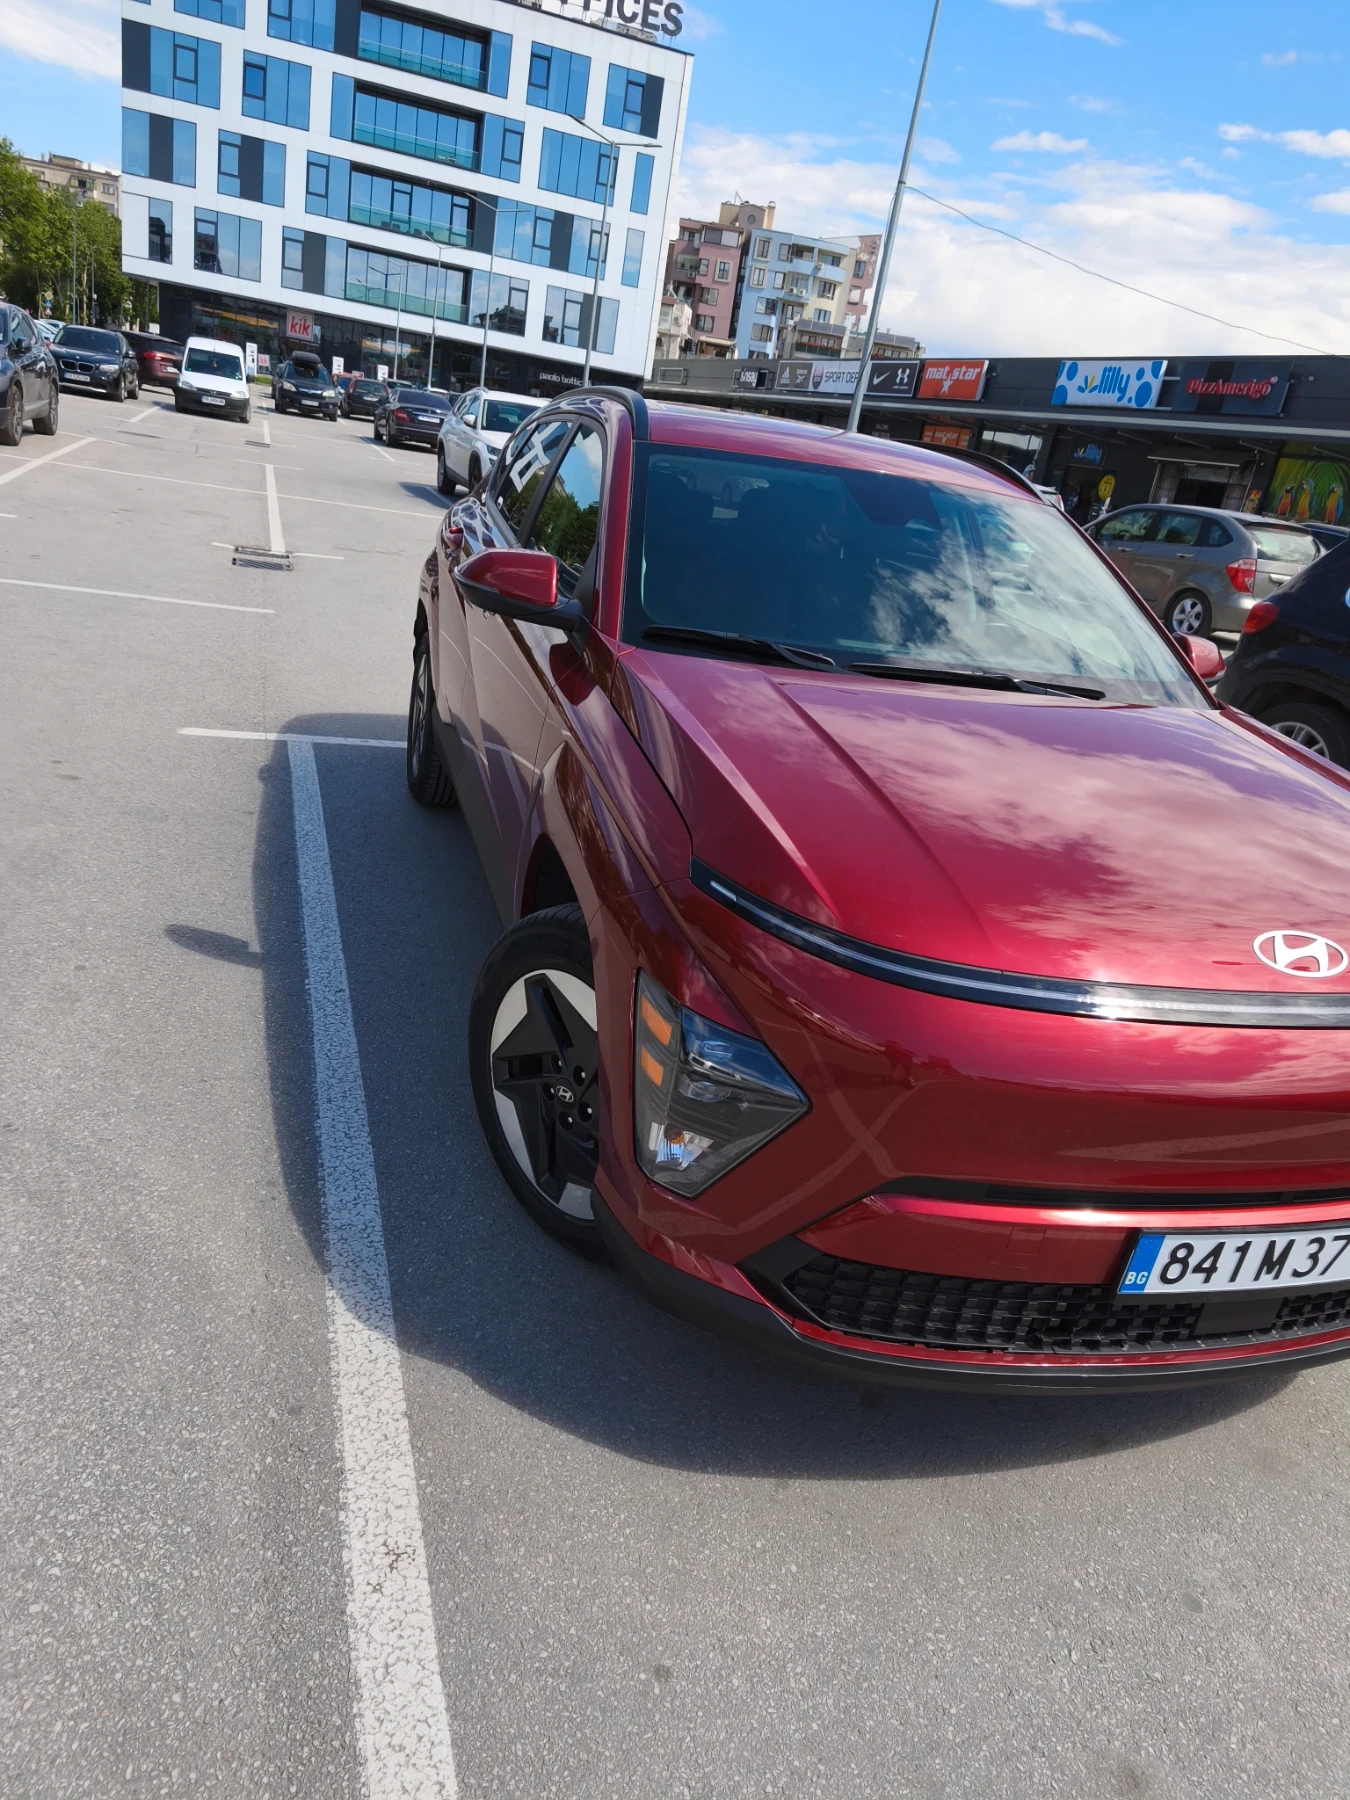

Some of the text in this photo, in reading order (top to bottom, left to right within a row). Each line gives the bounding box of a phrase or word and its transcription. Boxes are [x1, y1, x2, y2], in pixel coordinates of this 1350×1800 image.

[560, 0, 684, 36] ICES
[539, 372, 560, 382] paolo
[739, 368, 758, 387] sinsay
[825, 371, 844, 384] SPORT
[925, 366, 981, 380] mat star
[1098, 366, 1130, 402] lilly
[1124, 1271, 1148, 1285] BG
